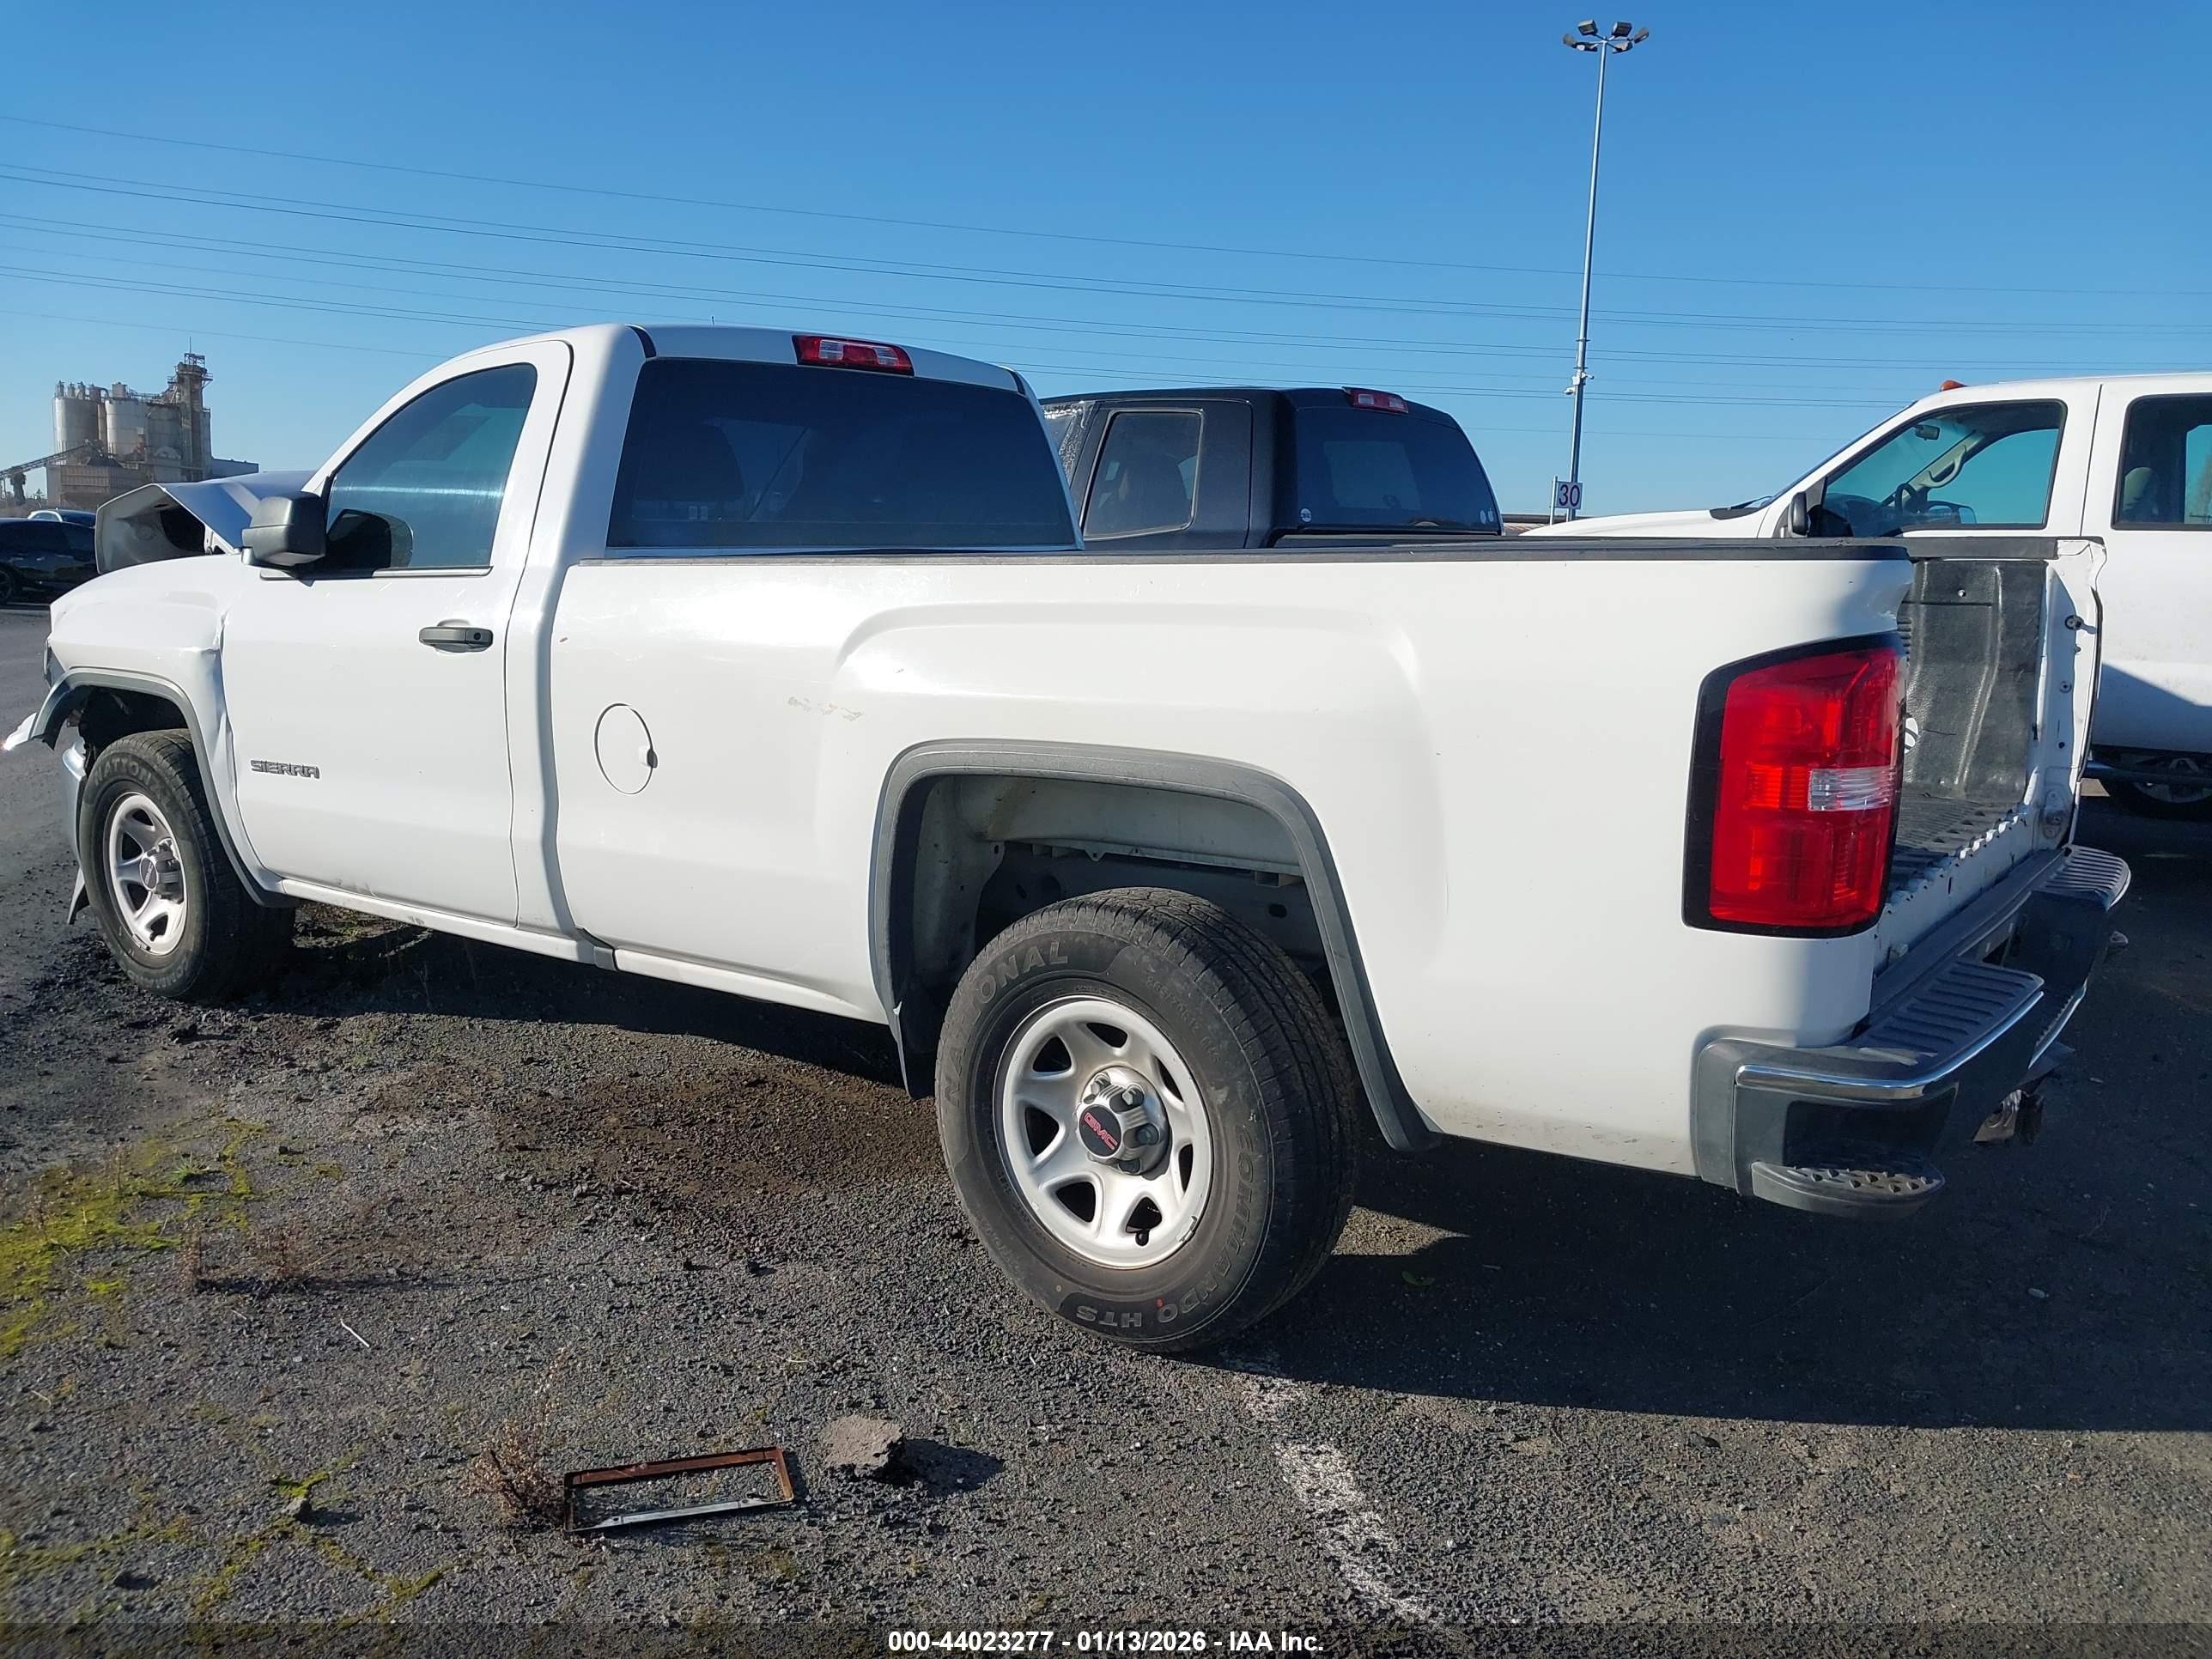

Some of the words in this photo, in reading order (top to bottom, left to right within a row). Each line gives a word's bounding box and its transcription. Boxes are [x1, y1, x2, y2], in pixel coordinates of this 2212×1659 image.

[1559, 484, 1581, 507] 30
[250, 760, 320, 779] SIERRA
[1084, 1112, 1118, 1151] GMC
[1075, 1304, 1143, 1328] HTS
